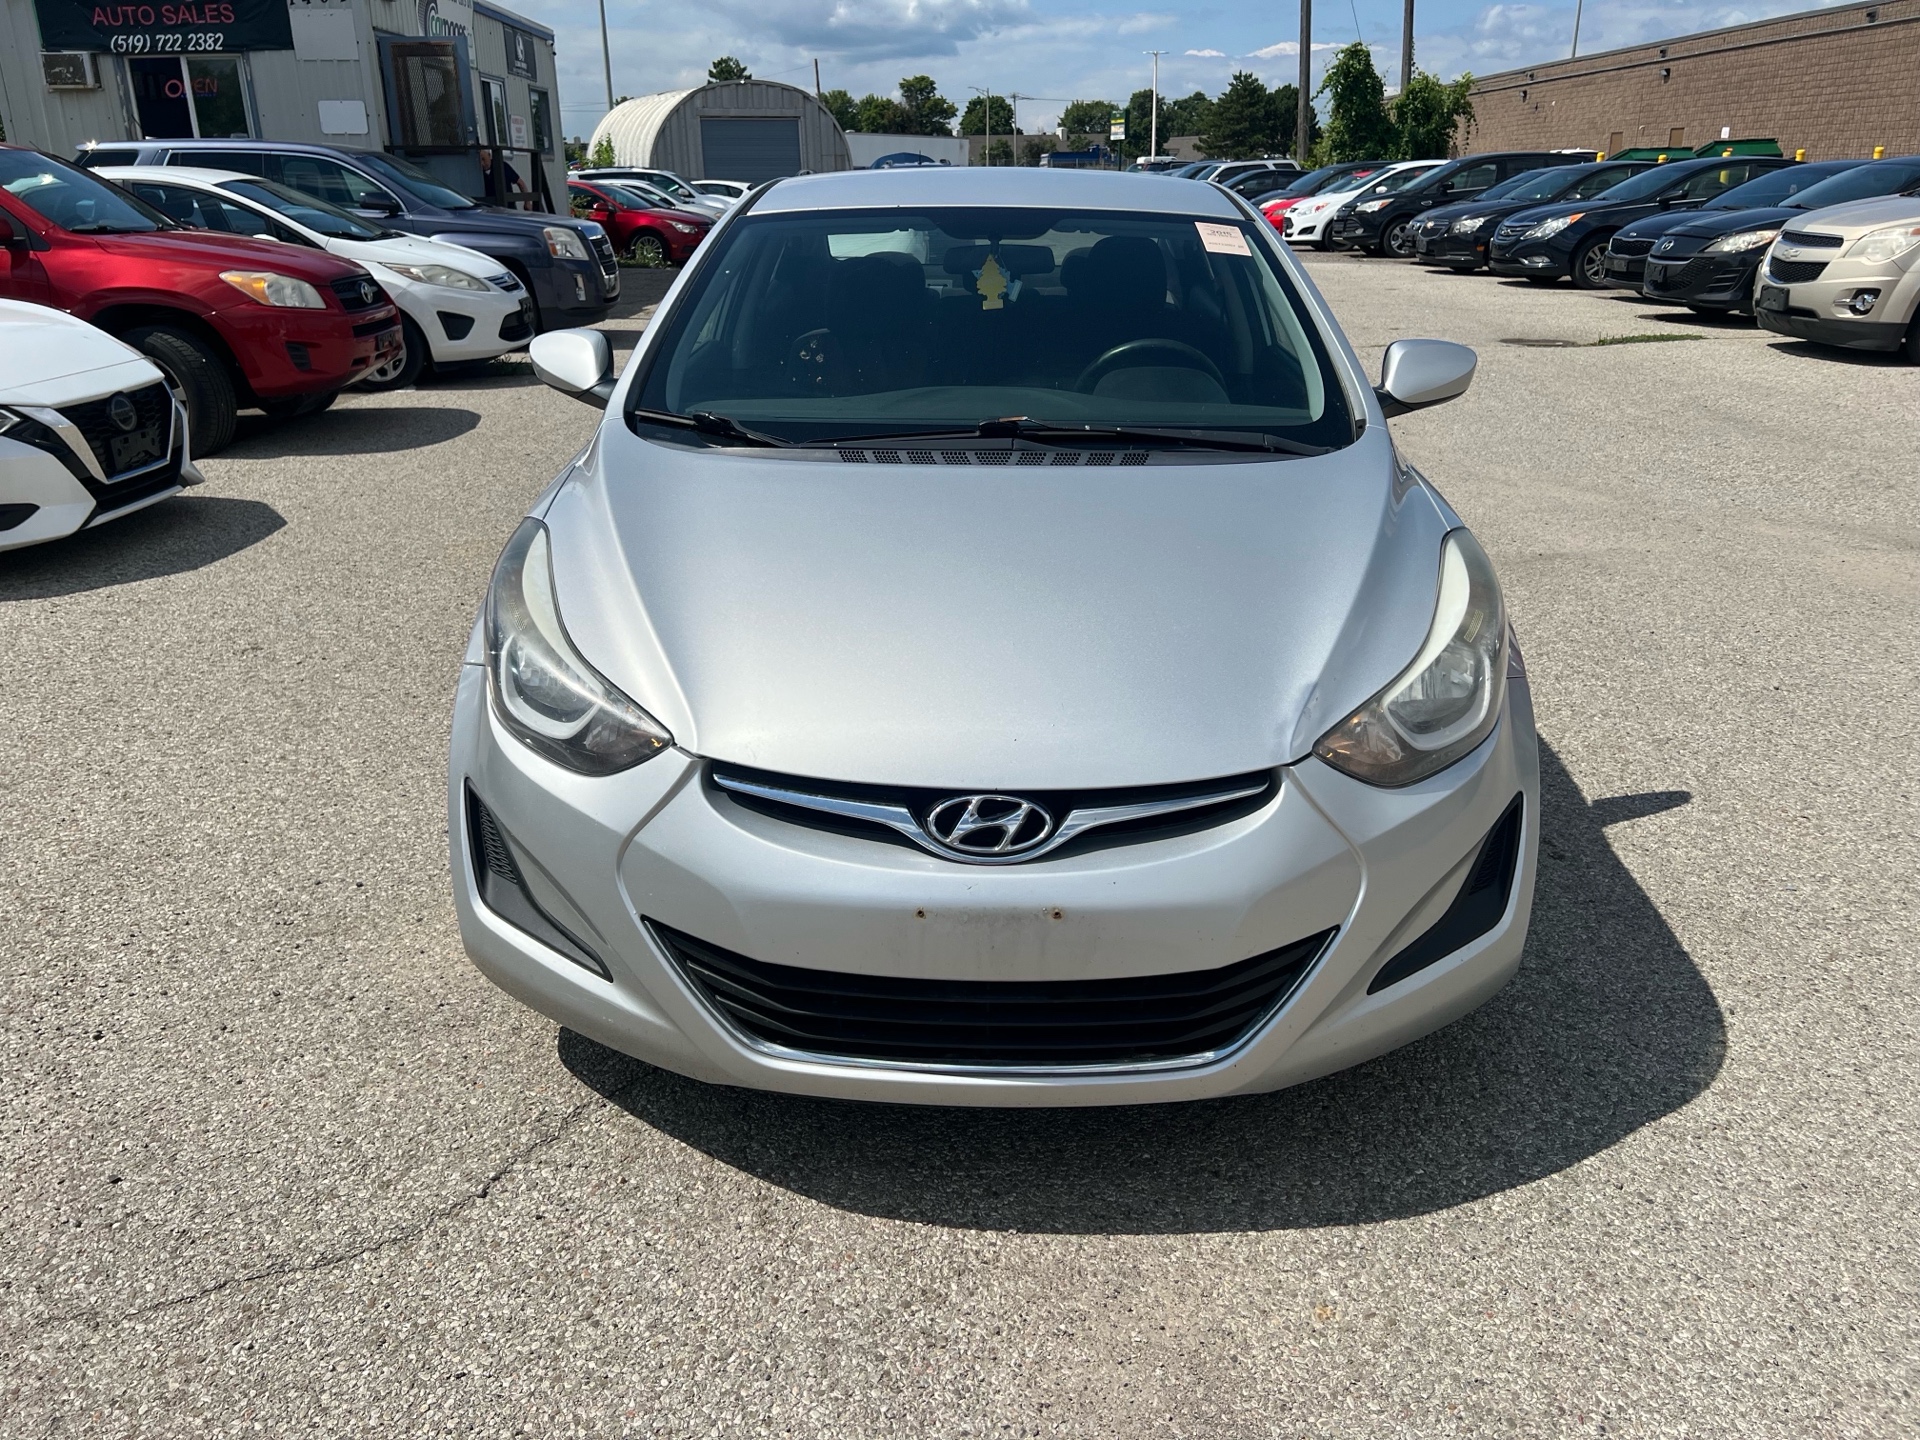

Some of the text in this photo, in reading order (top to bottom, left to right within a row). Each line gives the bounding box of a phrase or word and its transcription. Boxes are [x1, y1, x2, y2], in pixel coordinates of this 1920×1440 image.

[93, 4, 235, 26] AUTO SALES
[110, 33, 224, 53] (519) 722 2382
[165, 77, 218, 98] OEN
